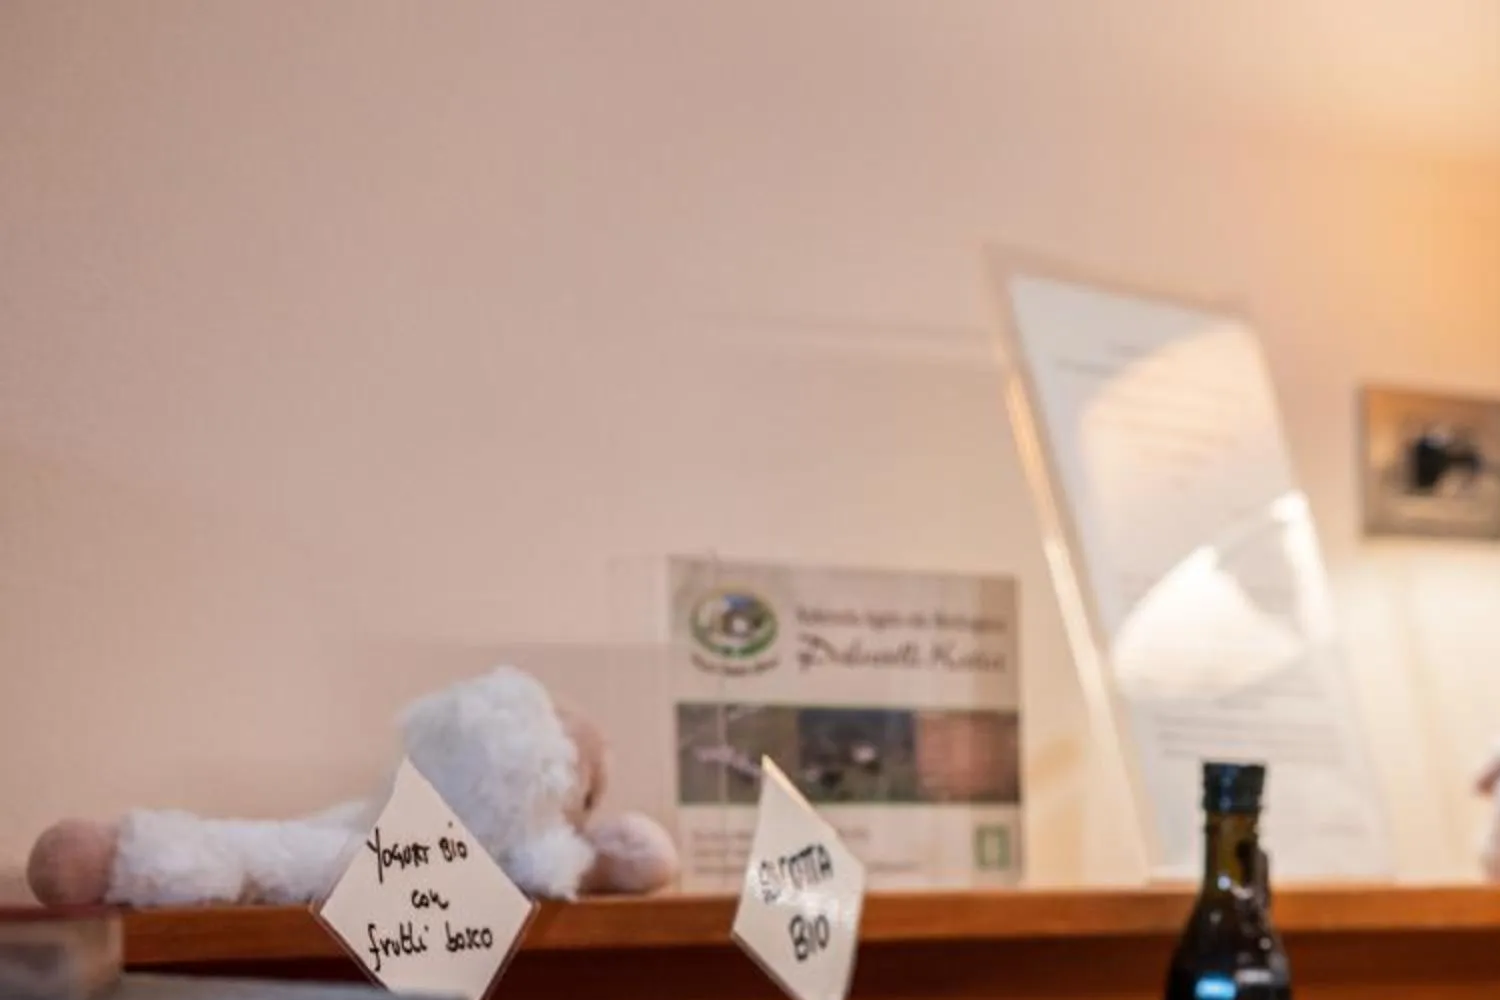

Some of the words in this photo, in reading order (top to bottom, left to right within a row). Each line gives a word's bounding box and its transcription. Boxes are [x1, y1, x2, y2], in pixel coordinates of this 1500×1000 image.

[411, 889, 449, 909] con
[367, 921, 430, 971] frutti
[445, 920, 493, 952] bosco
